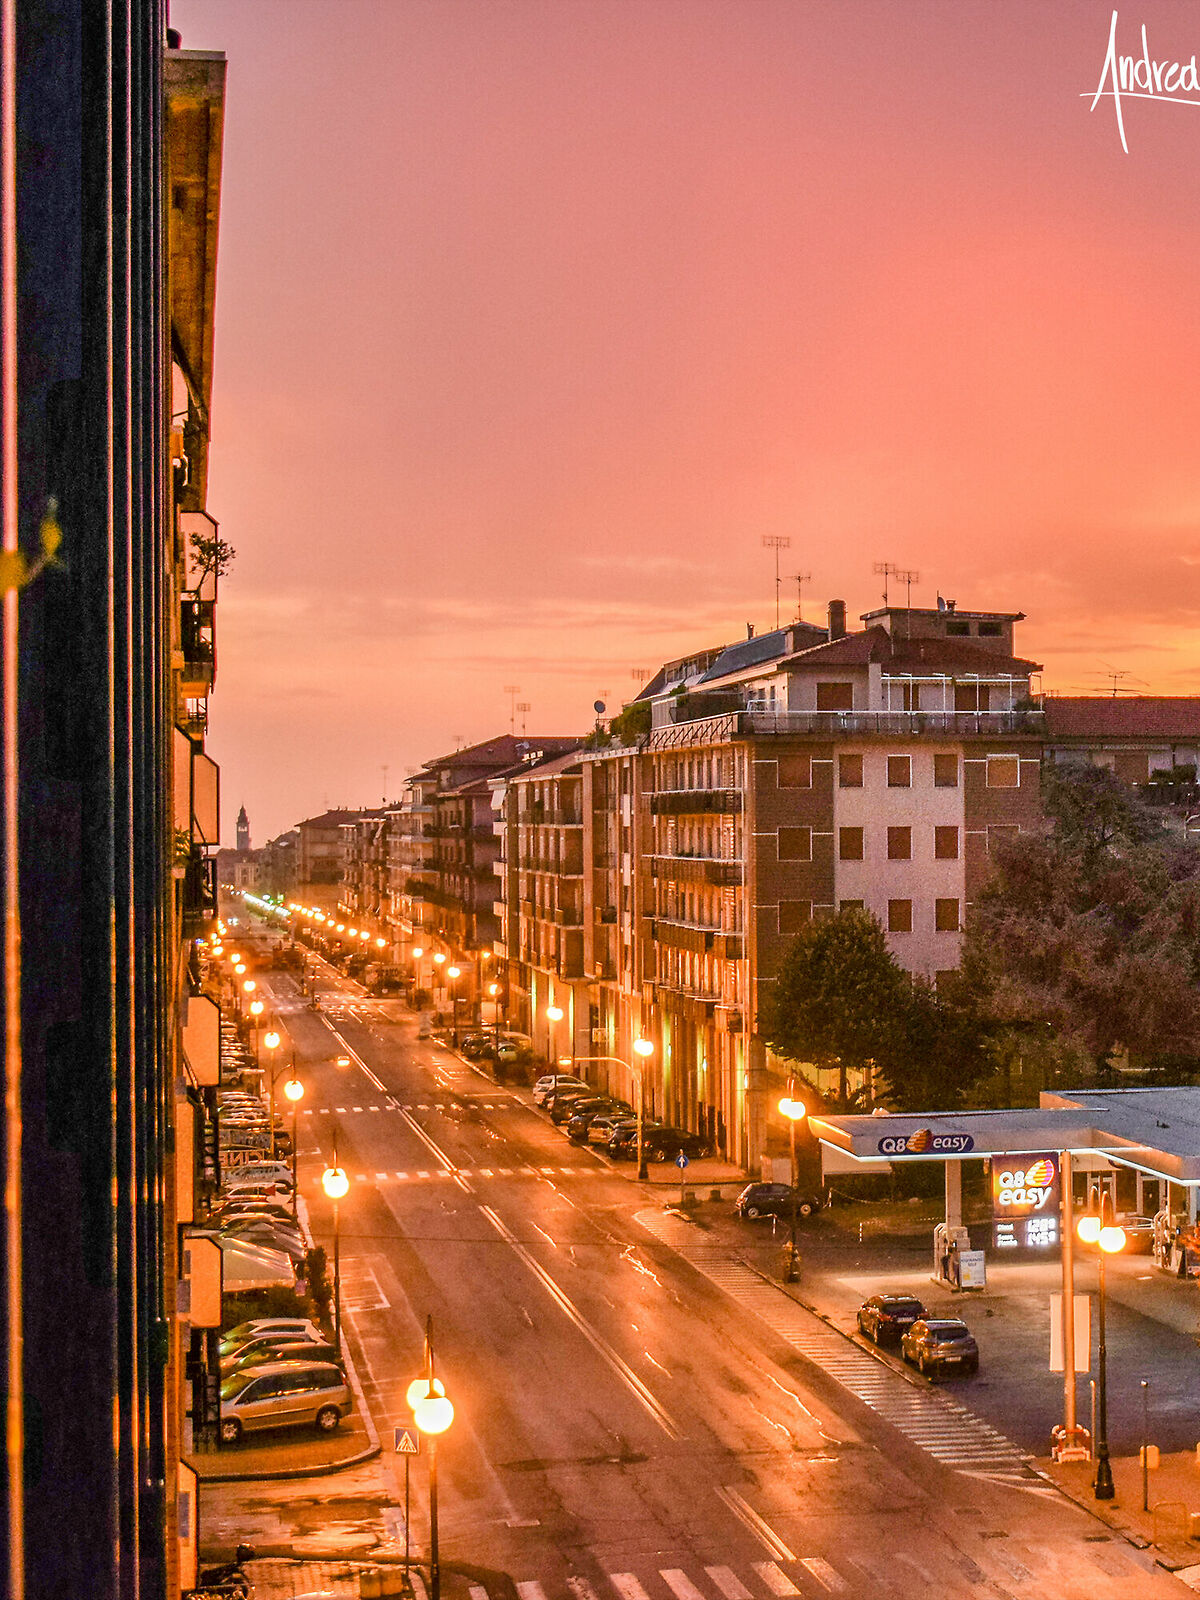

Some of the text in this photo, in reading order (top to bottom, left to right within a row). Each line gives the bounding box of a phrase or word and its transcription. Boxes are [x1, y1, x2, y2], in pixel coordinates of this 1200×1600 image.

[882, 1136, 969, 1153] Q8 easy
[998, 1170, 1025, 1188] Q8
[998, 1186, 1052, 1209] easy
